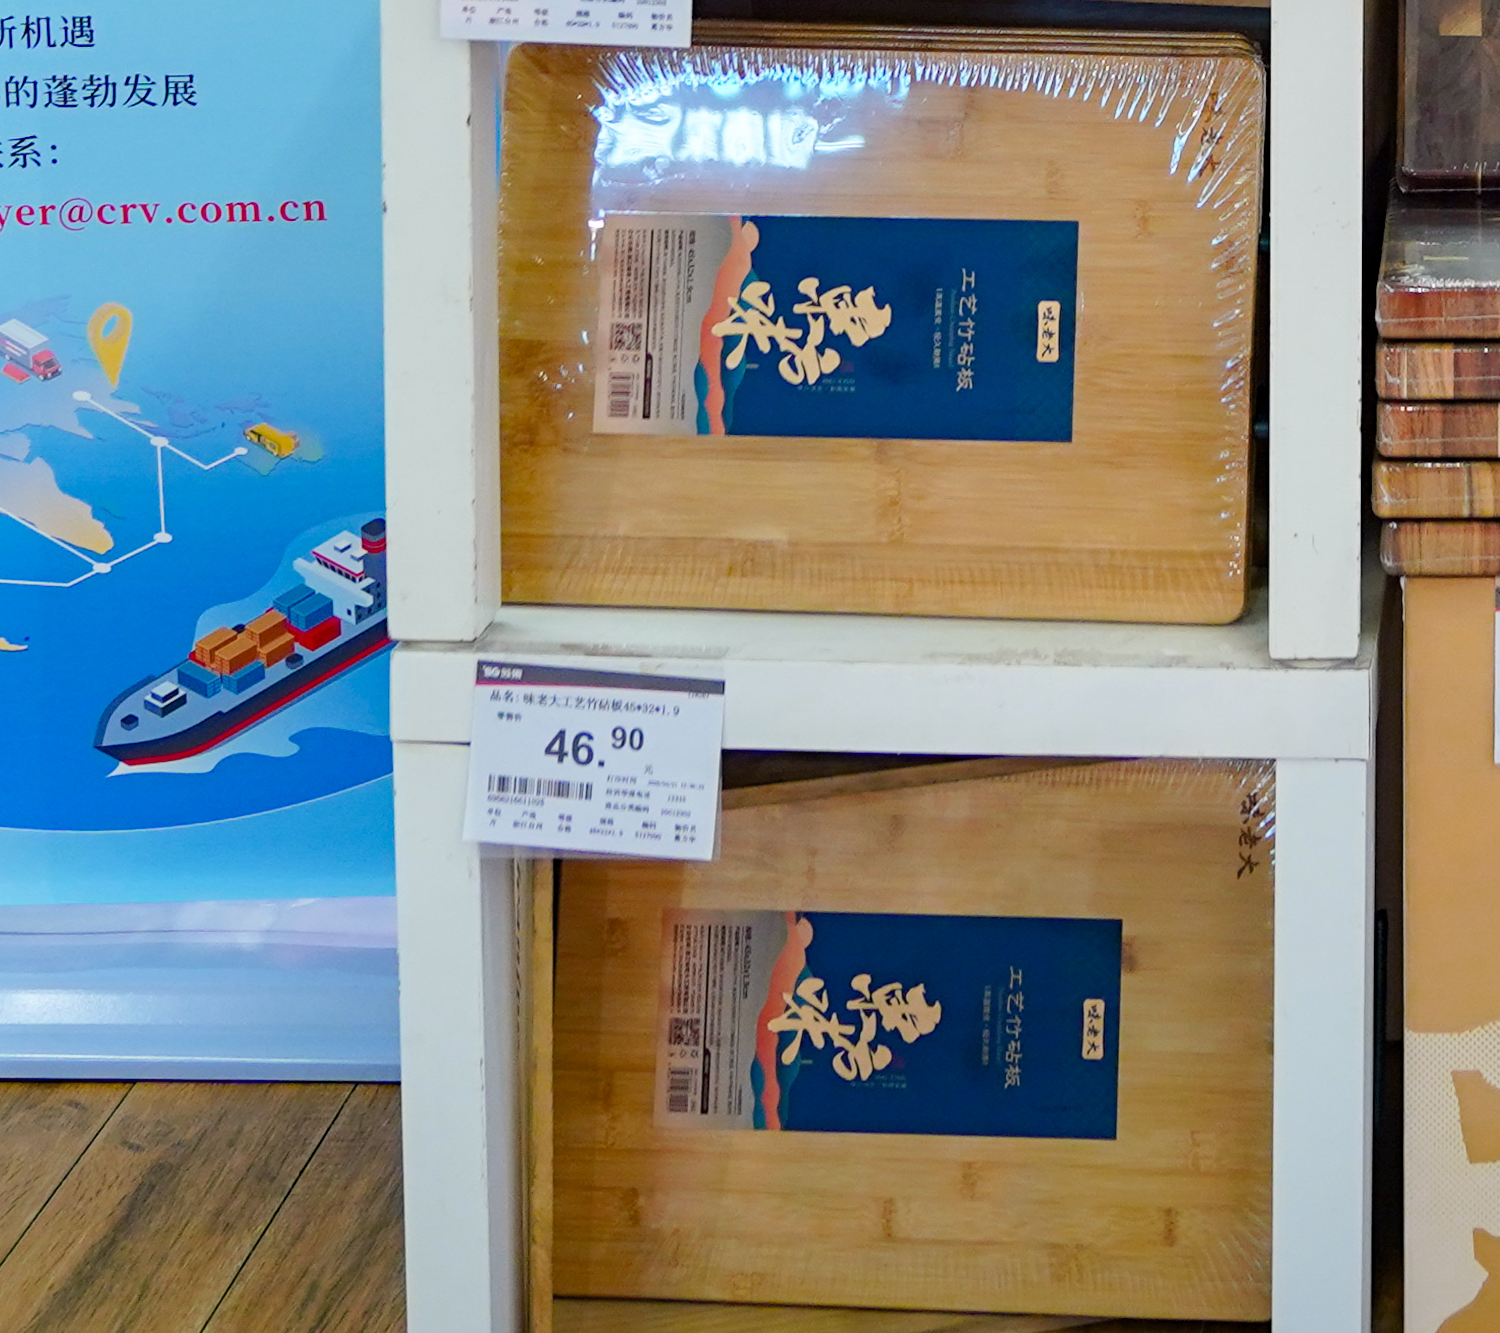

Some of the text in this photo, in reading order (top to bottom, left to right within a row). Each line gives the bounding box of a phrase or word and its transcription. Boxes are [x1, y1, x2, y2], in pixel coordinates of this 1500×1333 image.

[956, 268, 978, 392] 工艺竹砧板
[1040, 305, 1056, 358] 味老大
[1004, 966, 1026, 1089] 工艺竹砧板
[1086, 1004, 1103, 1056] 味老大
